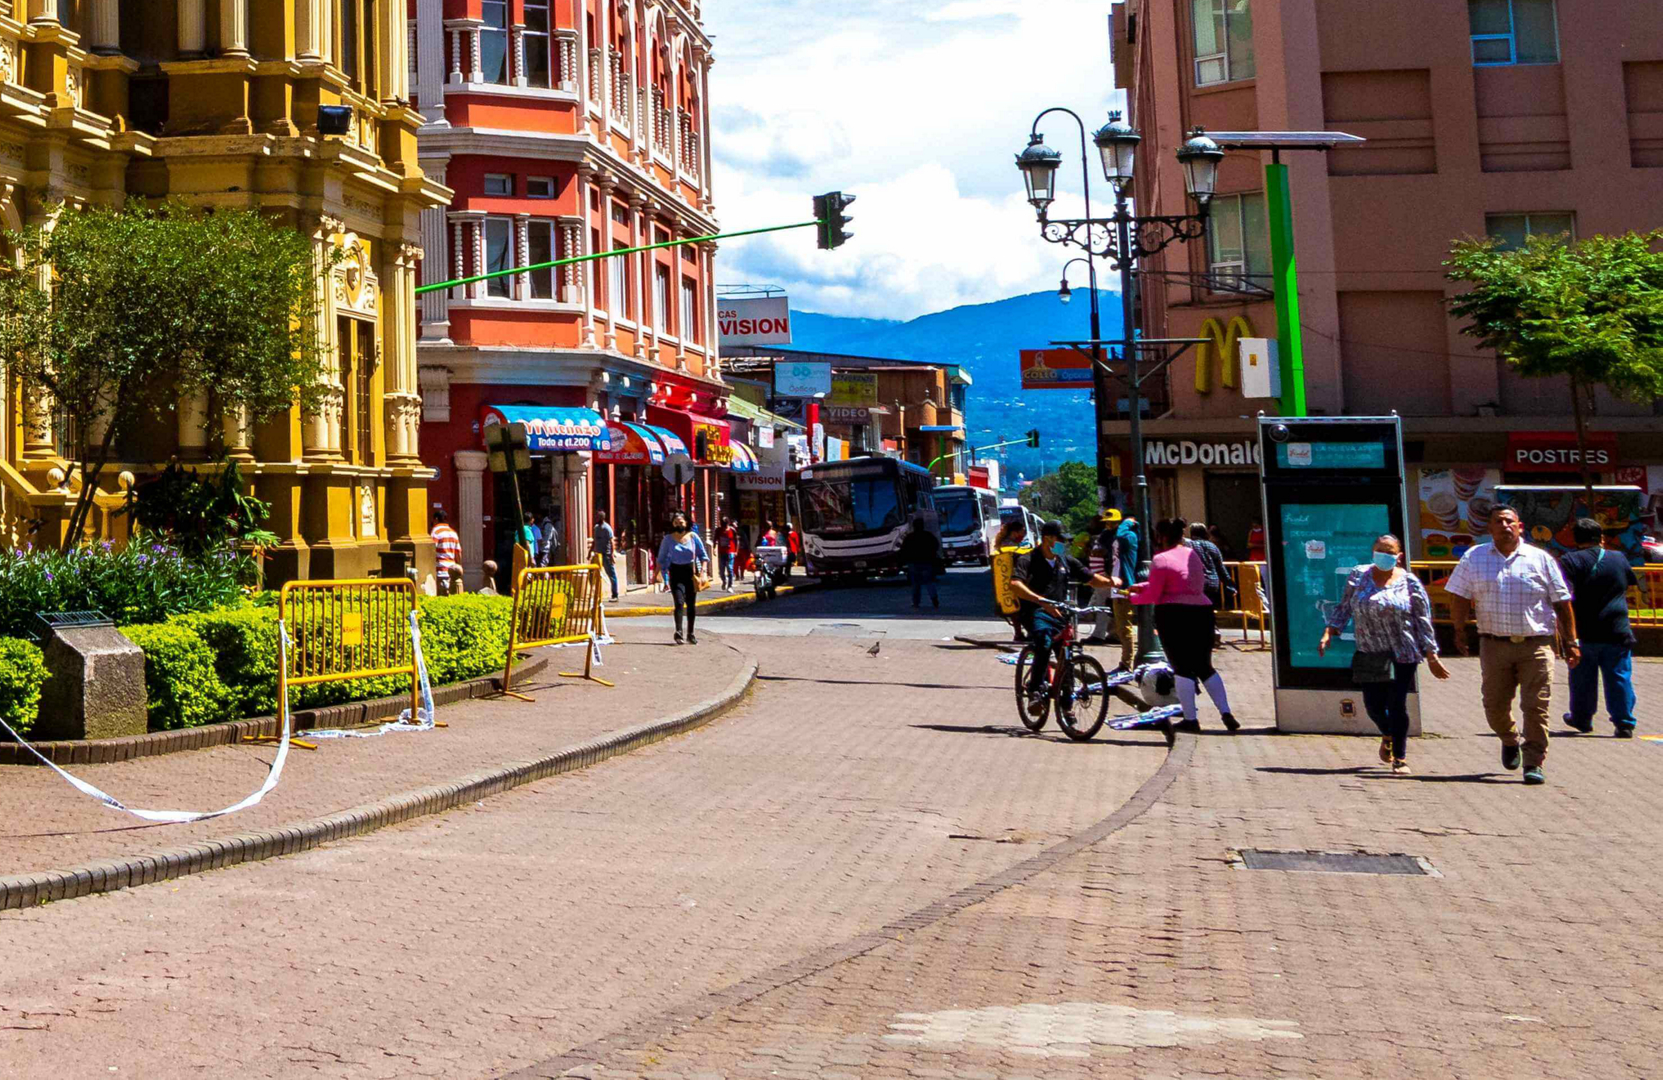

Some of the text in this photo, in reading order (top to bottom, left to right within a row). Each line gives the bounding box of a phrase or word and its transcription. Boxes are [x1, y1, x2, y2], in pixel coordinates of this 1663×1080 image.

[719, 318, 789, 336] VISION
[828, 408, 867, 418] VIDEO
[538, 438, 556, 447] Todo
[1516, 450, 1609, 464] POSTRES
[748, 477, 782, 485] VISION
